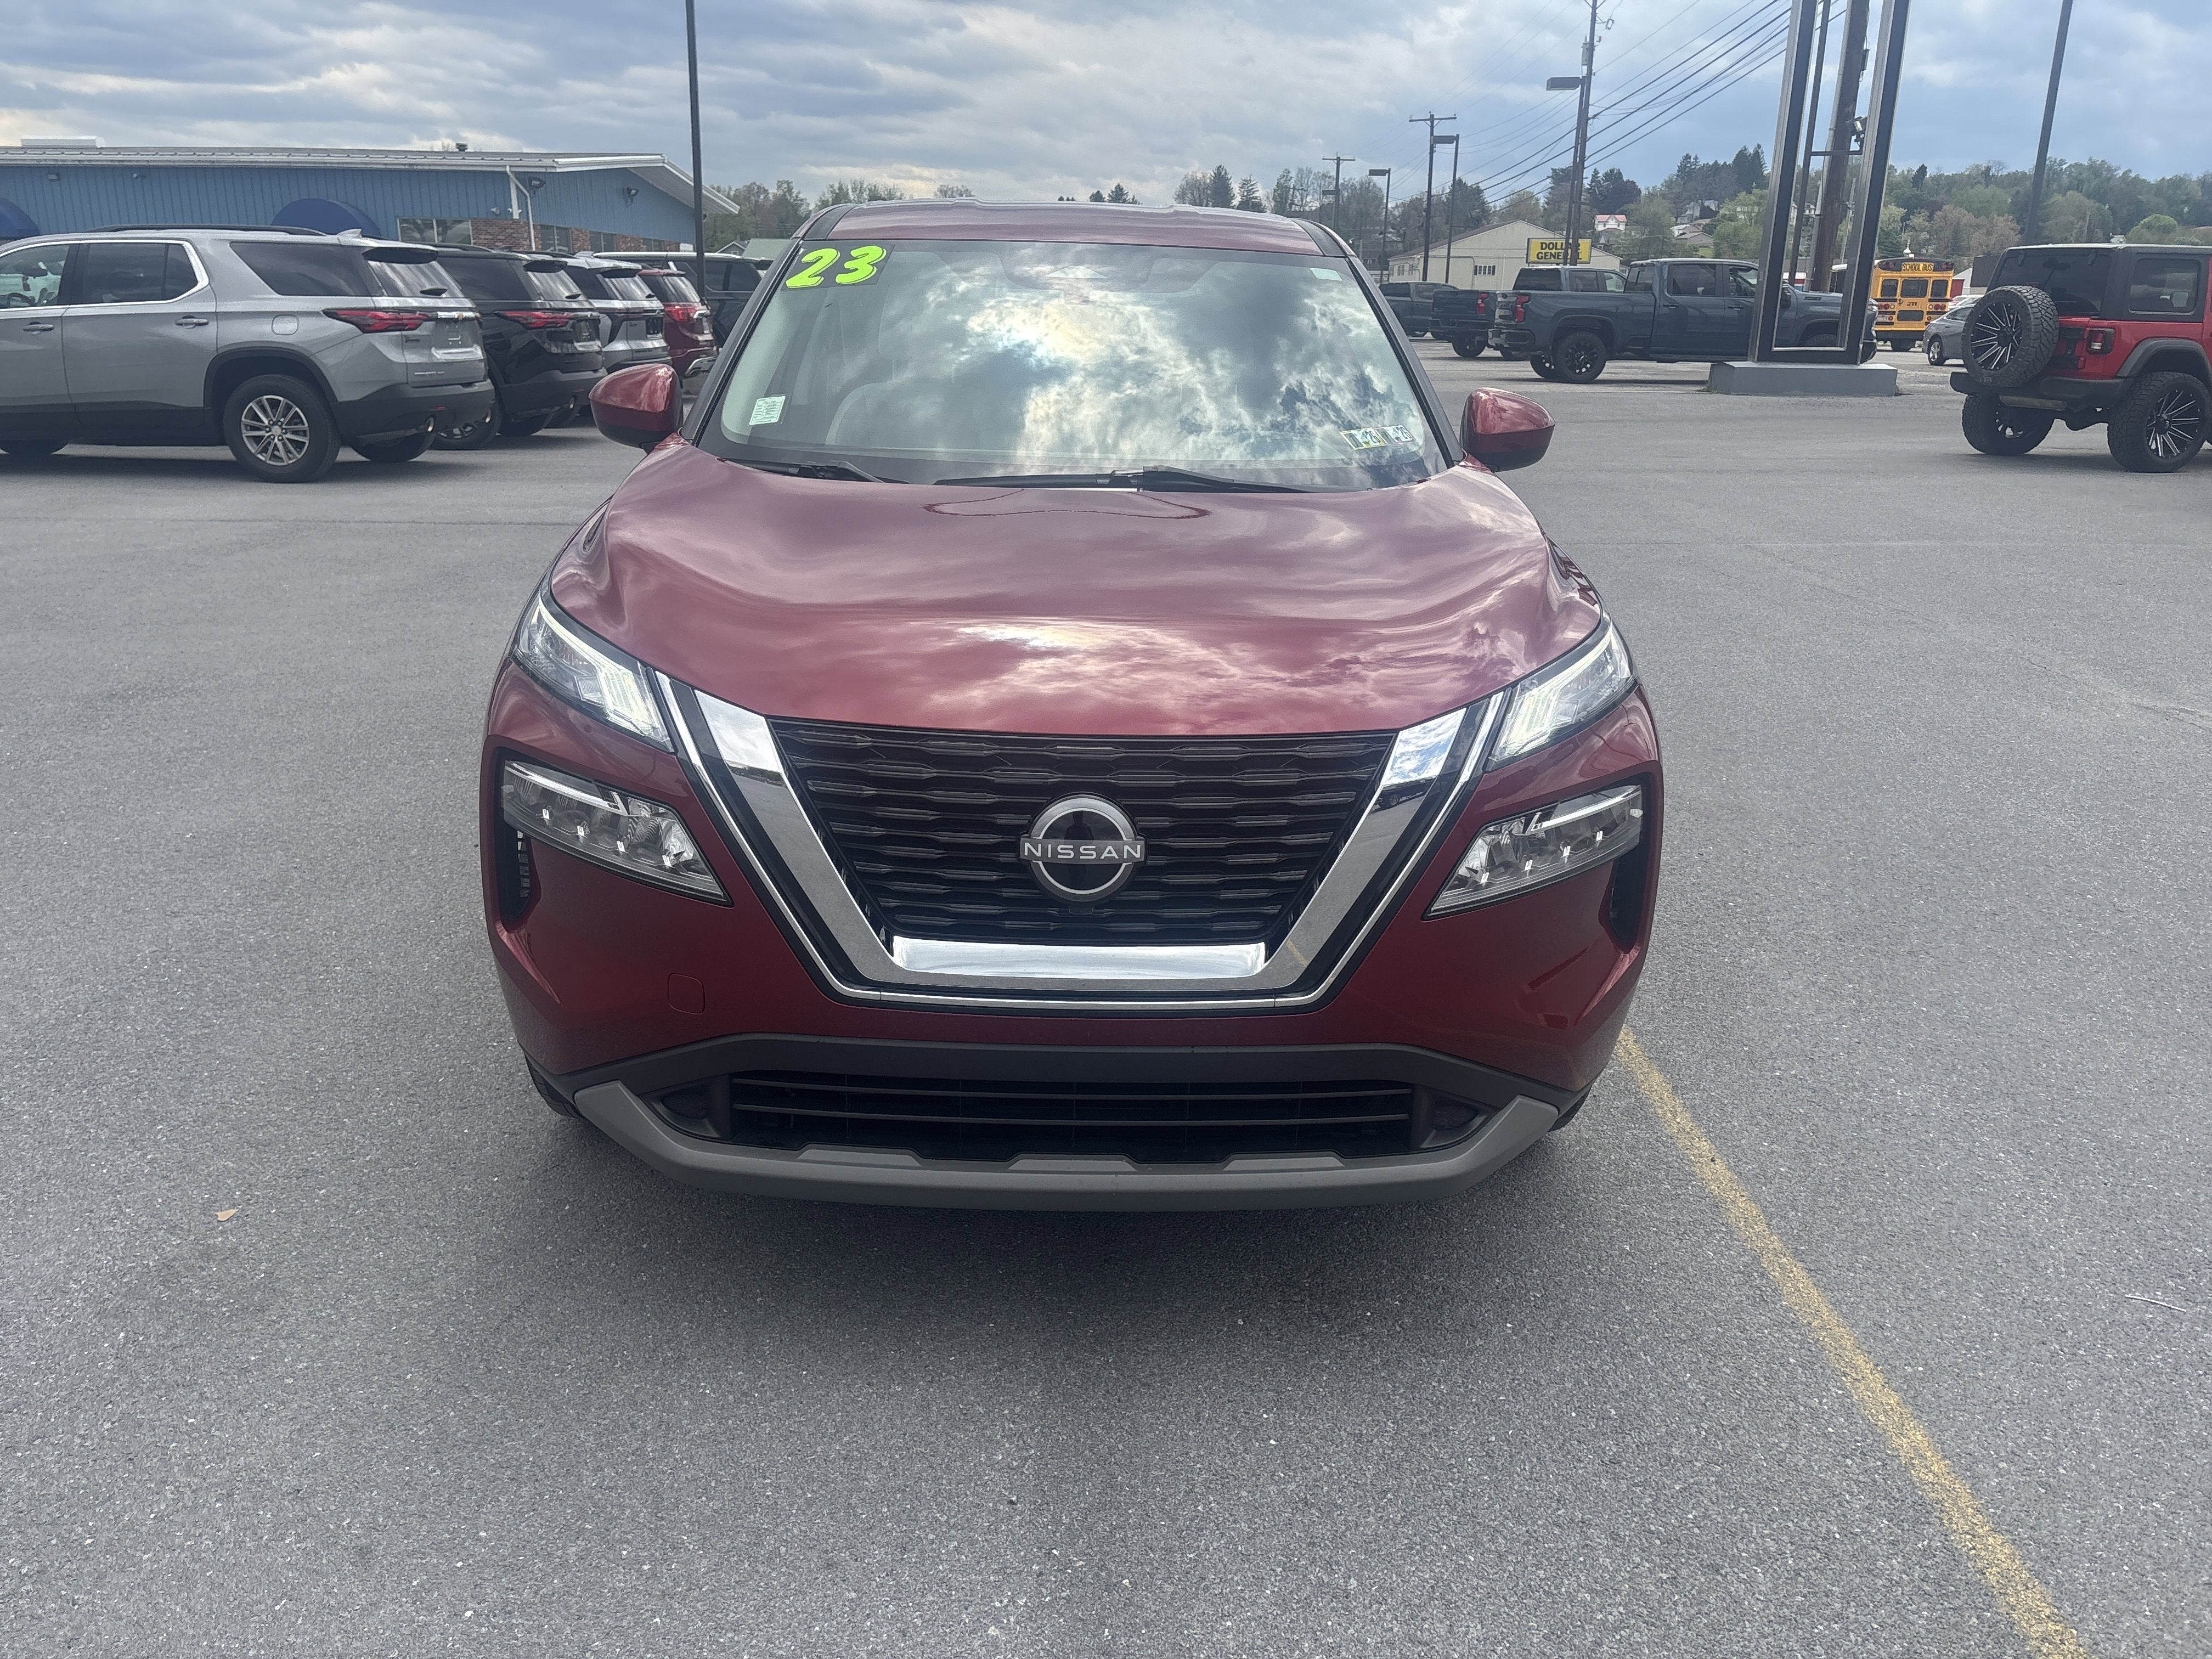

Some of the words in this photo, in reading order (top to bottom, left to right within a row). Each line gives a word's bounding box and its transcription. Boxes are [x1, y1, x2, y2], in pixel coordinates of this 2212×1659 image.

[1540, 242, 1581, 250] DOLL
[1537, 251, 1582, 259] GENEL
[786, 245, 887, 289] 23
[1024, 842, 1141, 859] NISSAN
